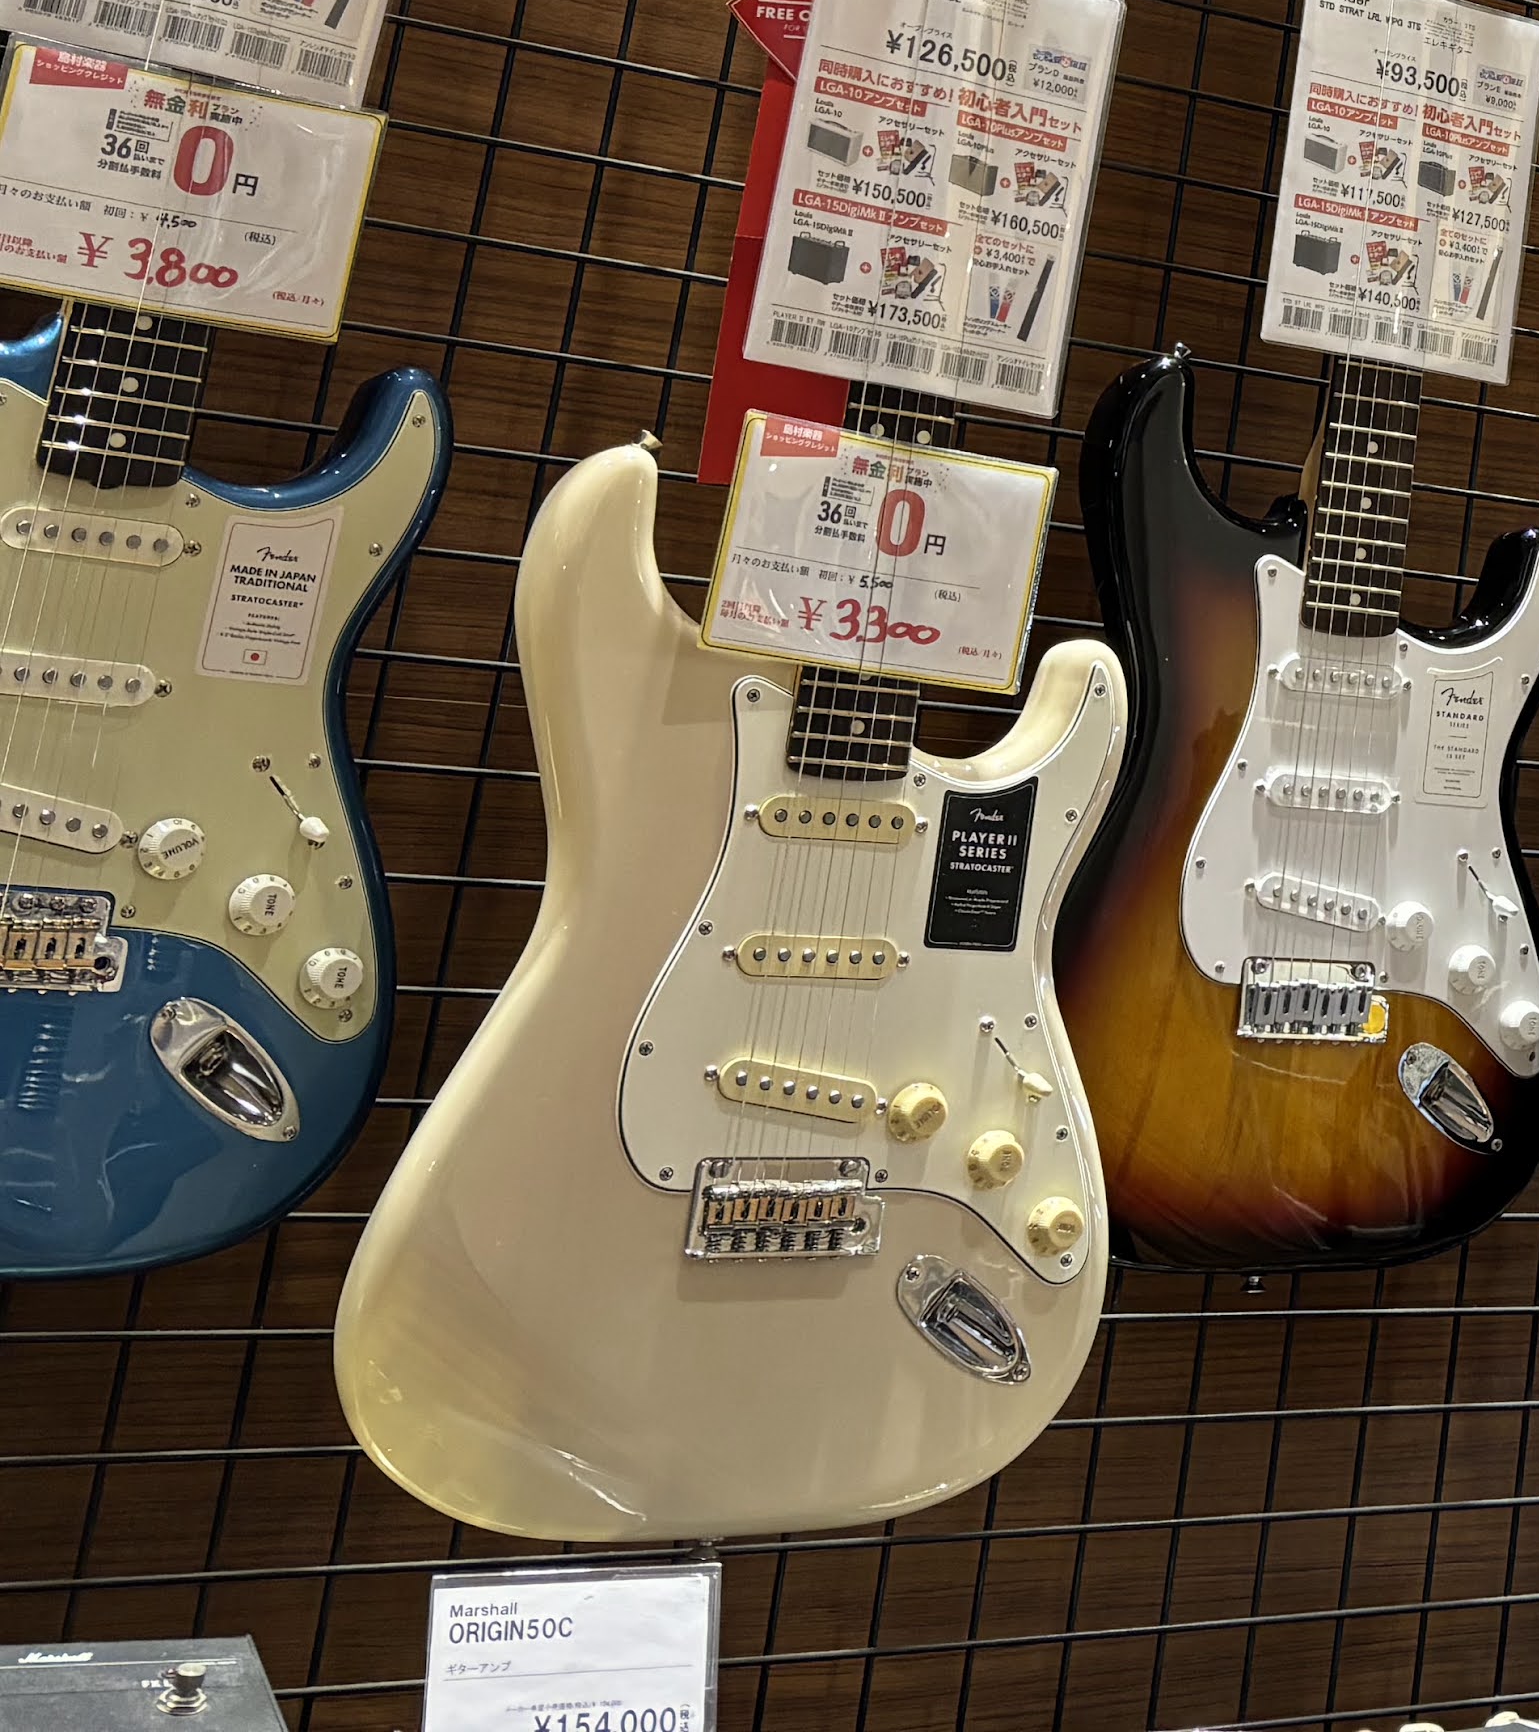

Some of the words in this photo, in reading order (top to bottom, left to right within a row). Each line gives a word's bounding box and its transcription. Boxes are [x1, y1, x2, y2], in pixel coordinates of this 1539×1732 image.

[757, 6, 795, 21] FREE
[1424, 37, 1473, 55] エレキギター
[885, 30, 1008, 84] ¥126,500
[1376, 58, 1460, 98] ¥93,500
[144, 89, 209, 118] 無金利
[814, 105, 843, 118] LGA-10
[959, 87, 1082, 135] 初心者入門セット
[1422, 103, 1522, 141] 初心者入門セット
[852, 178, 926, 209] ¥150,500
[990, 209, 1060, 240] ¥160,500
[1452, 207, 1506, 232] ¥127,500
[1358, 285, 1417, 312] ¥140,500
[868, 299, 941, 329] ¥173,500
[815, 525, 865, 543] 分割払手数料
[257, 546, 298, 562] Fender
[230, 564, 263, 577] MADE
[265, 568, 278, 579] IN
[279, 570, 316, 583] JAPAN
[233, 575, 308, 593] TRADITIONAL
[231, 594, 300, 608] STRATOCASTER
[1441, 687, 1485, 706] Fender
[1436, 711, 1484, 721] STANDARD
[970, 808, 1003, 822] Fender
[952, 830, 1005, 845] PLAYER
[959, 845, 1007, 860] SERIES
[950, 862, 1011, 873] STRATOCASTER
[449, 1602, 518, 1619] Marshall
[449, 1617, 573, 1645] ORIGIN50C
[446, 1661, 512, 1676] ギターアンプ
